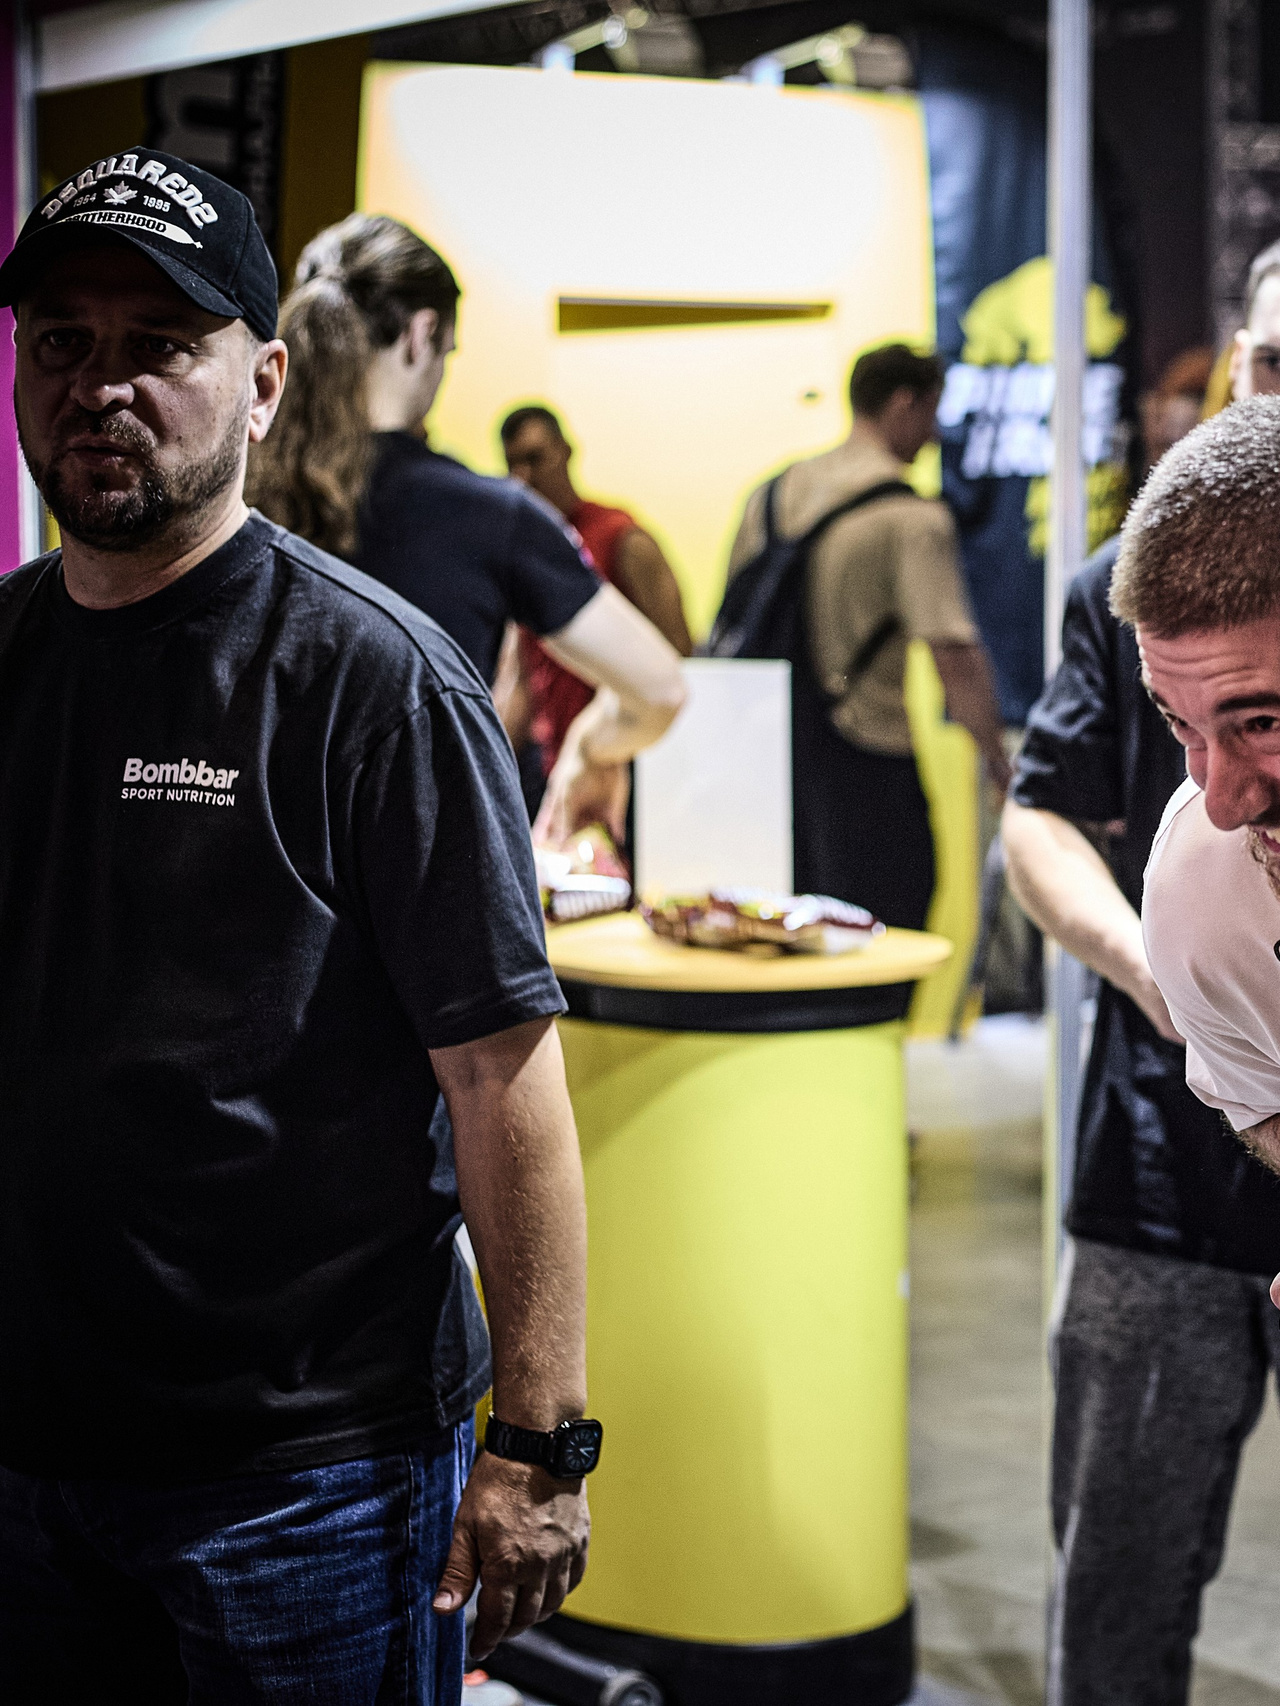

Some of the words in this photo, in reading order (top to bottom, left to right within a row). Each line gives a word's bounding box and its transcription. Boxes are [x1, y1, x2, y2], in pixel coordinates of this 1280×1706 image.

[40, 153, 219, 230] DSQUARED2
[142, 195, 172, 213] 1995
[123, 758, 239, 789] Bombbar
[121, 787, 163, 800] SPORT
[166, 789, 235, 807] NUTRITION
